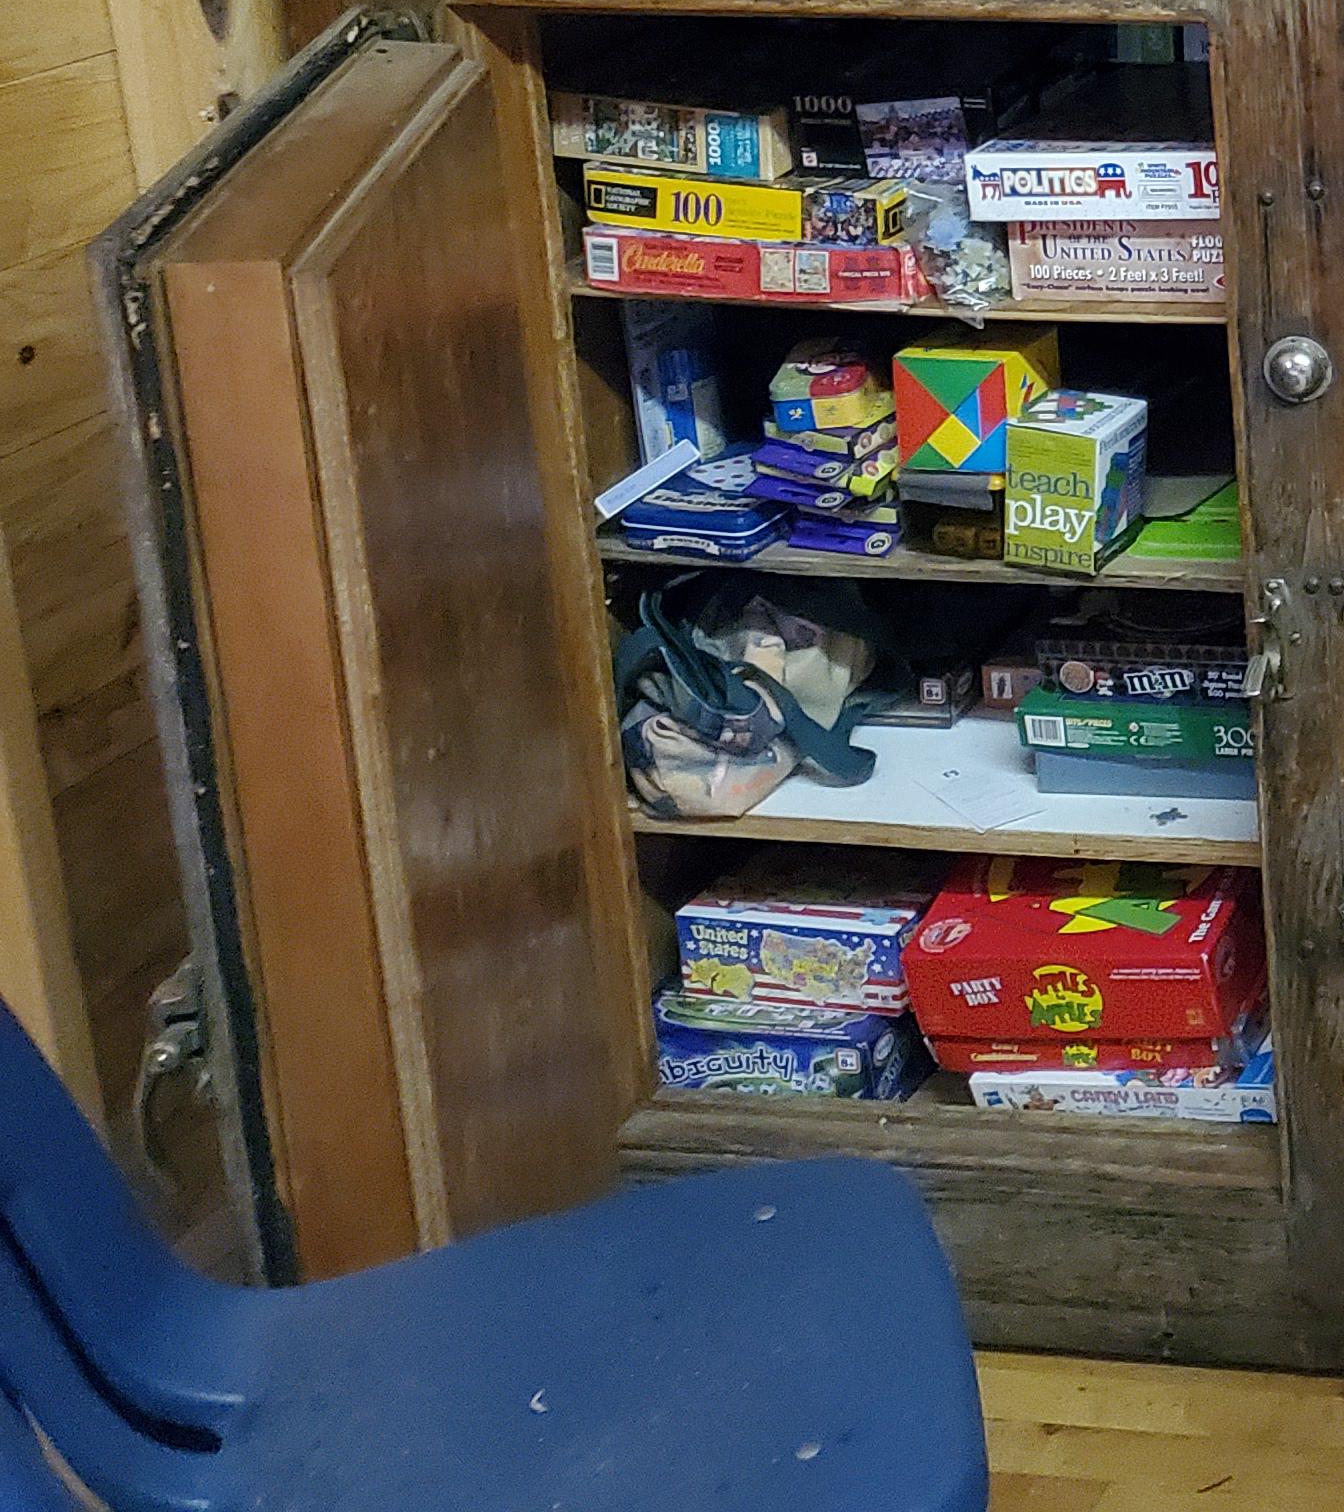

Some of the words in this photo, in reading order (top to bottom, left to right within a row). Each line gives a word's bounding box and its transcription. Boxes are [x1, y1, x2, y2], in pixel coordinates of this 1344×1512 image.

[793, 95, 852, 114] 1000
[707, 122, 722, 166] 1000
[1002, 170, 1098, 195] POLITICS
[671, 191, 723, 226] 100
[1041, 234, 1112, 261] UNITED
[1118, 235, 1187, 262] STATES
[1030, 264, 1050, 279] 100
[1053, 265, 1092, 280] Pieces
[1108, 266, 1117, 281] 2
[1120, 268, 1147, 282] Feet
[1150, 272, 1158, 281] x
[1161, 268, 1169, 282] 3
[1007, 464, 1093, 500] teach
[1005, 494, 1095, 542] play
[1007, 541, 1092, 568] inspire
[690, 924, 749, 944] United
[1188, 921, 1212, 943] The
[698, 939, 749, 960] States
[950, 976, 1002, 996] PARTY
[965, 991, 999, 1006] BOX
[1070, 1089, 1129, 1106] CANDY
[1133, 1090, 1179, 1106] LAND
